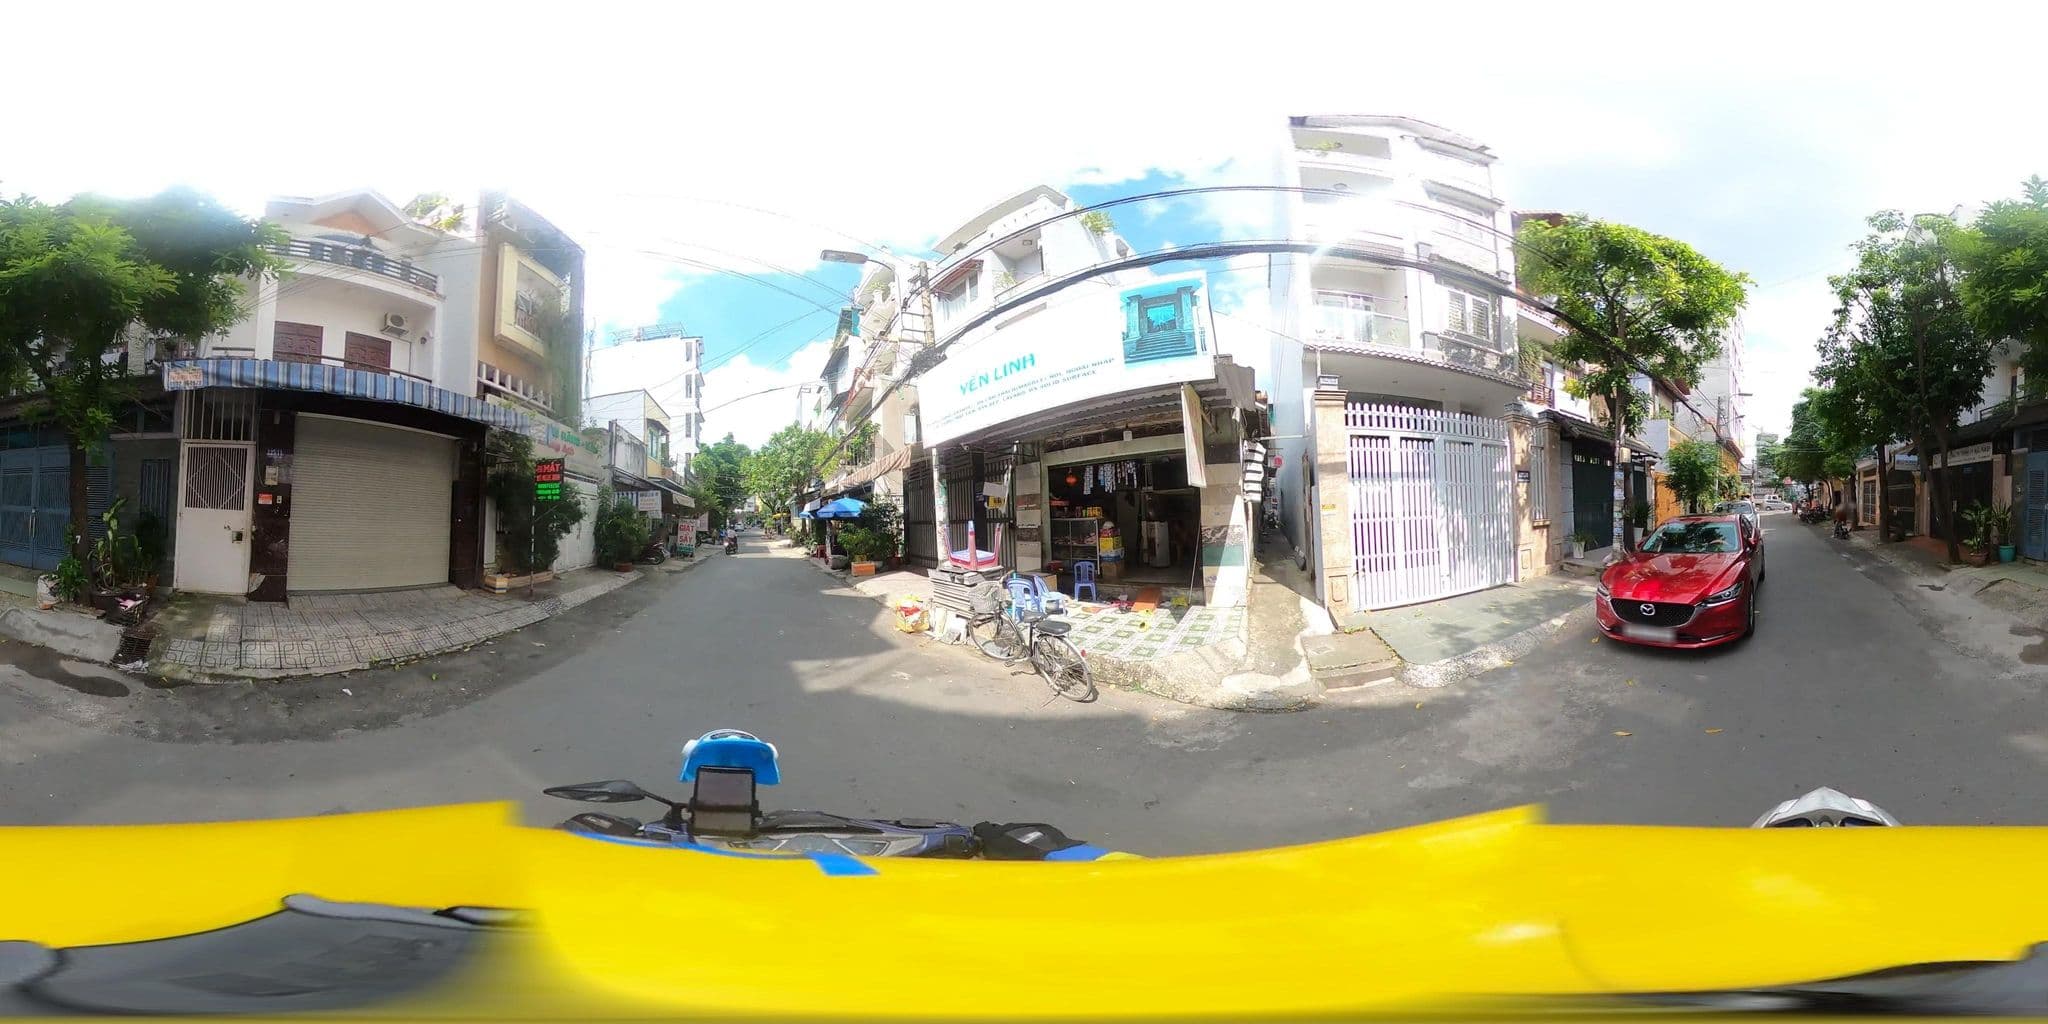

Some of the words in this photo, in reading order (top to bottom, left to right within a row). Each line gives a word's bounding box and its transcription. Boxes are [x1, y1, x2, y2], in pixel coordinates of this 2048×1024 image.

[960, 372, 989, 396] YÊN
[994, 353, 1035, 381] LINH
[75, 535, 81, 544] 7
